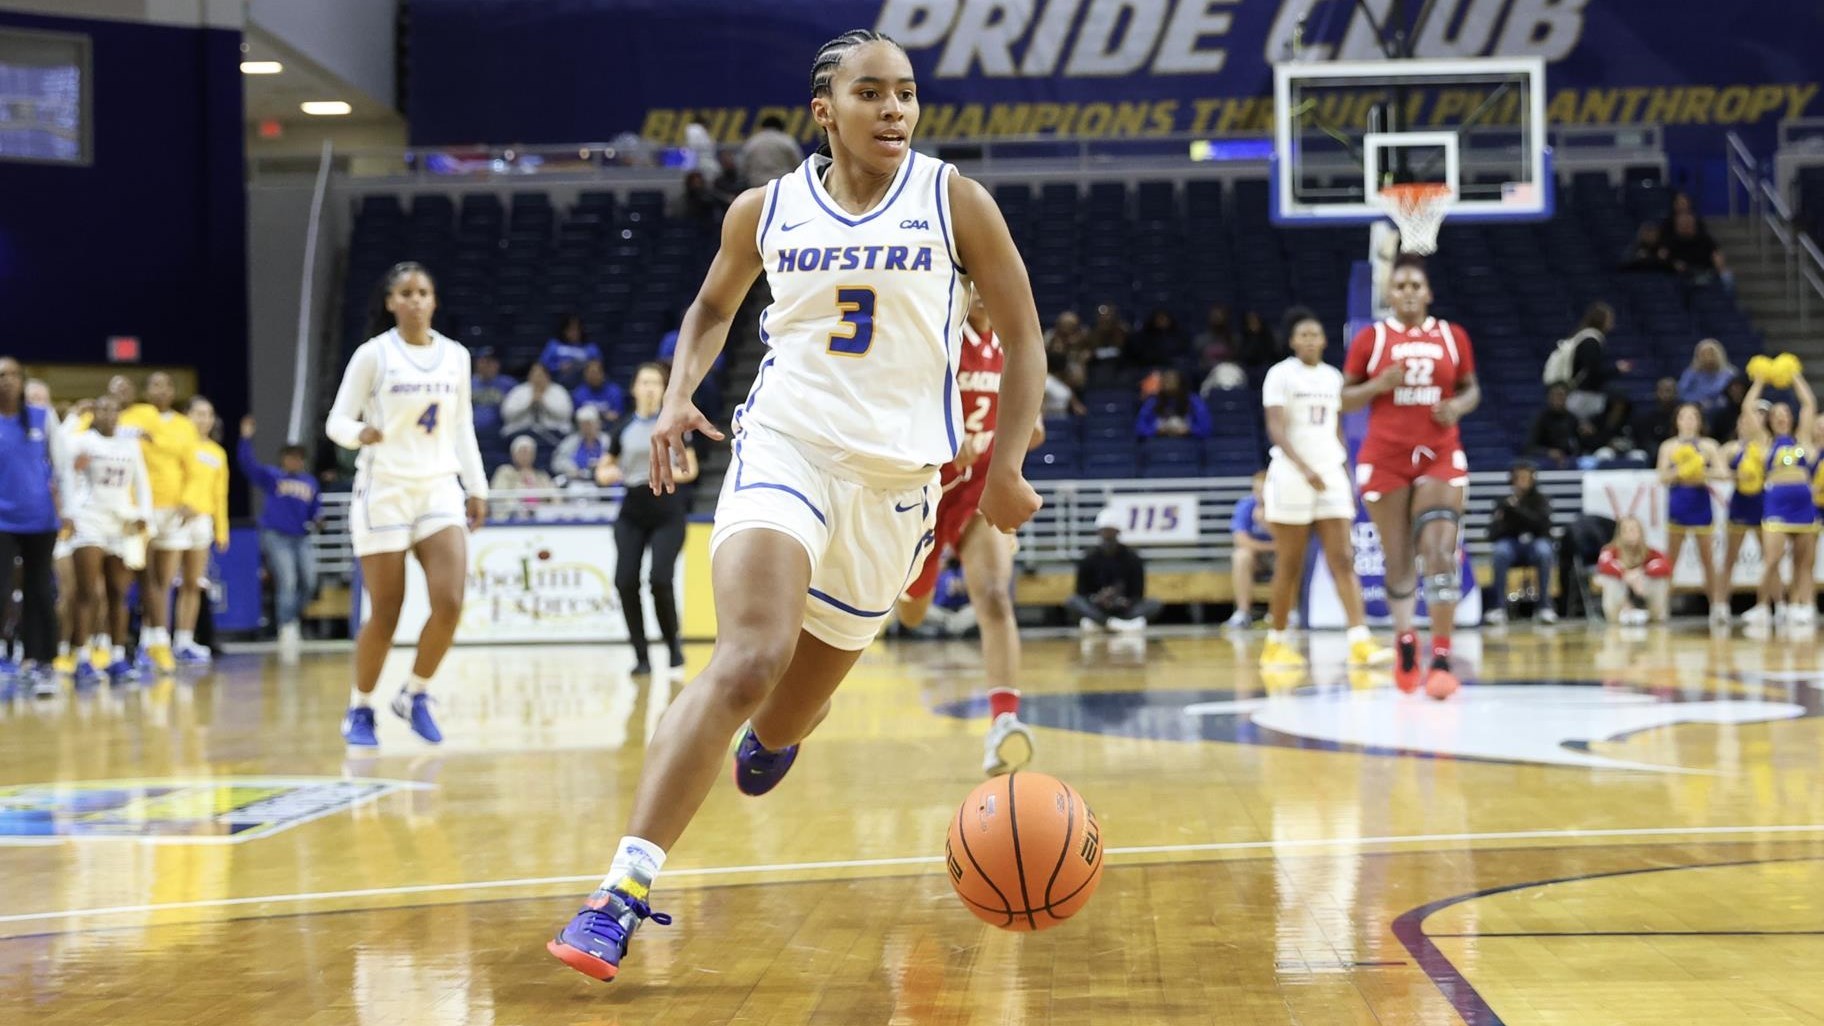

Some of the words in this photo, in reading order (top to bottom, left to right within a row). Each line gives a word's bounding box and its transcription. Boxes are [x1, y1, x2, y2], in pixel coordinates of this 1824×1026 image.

[872, 0, 1237, 78] PRIDE
[640, 108, 825, 146] BUILDIN
[909, 100, 1178, 139] HAMPIONS
[899, 219, 929, 230] CAA
[777, 246, 932, 273] HOFSTRA
[825, 285, 878, 358] 3
[1404, 358, 1435, 386] 22
[416, 402, 440, 435] 4
[965, 395, 992, 432] 2
[1127, 505, 1180, 532] 115
